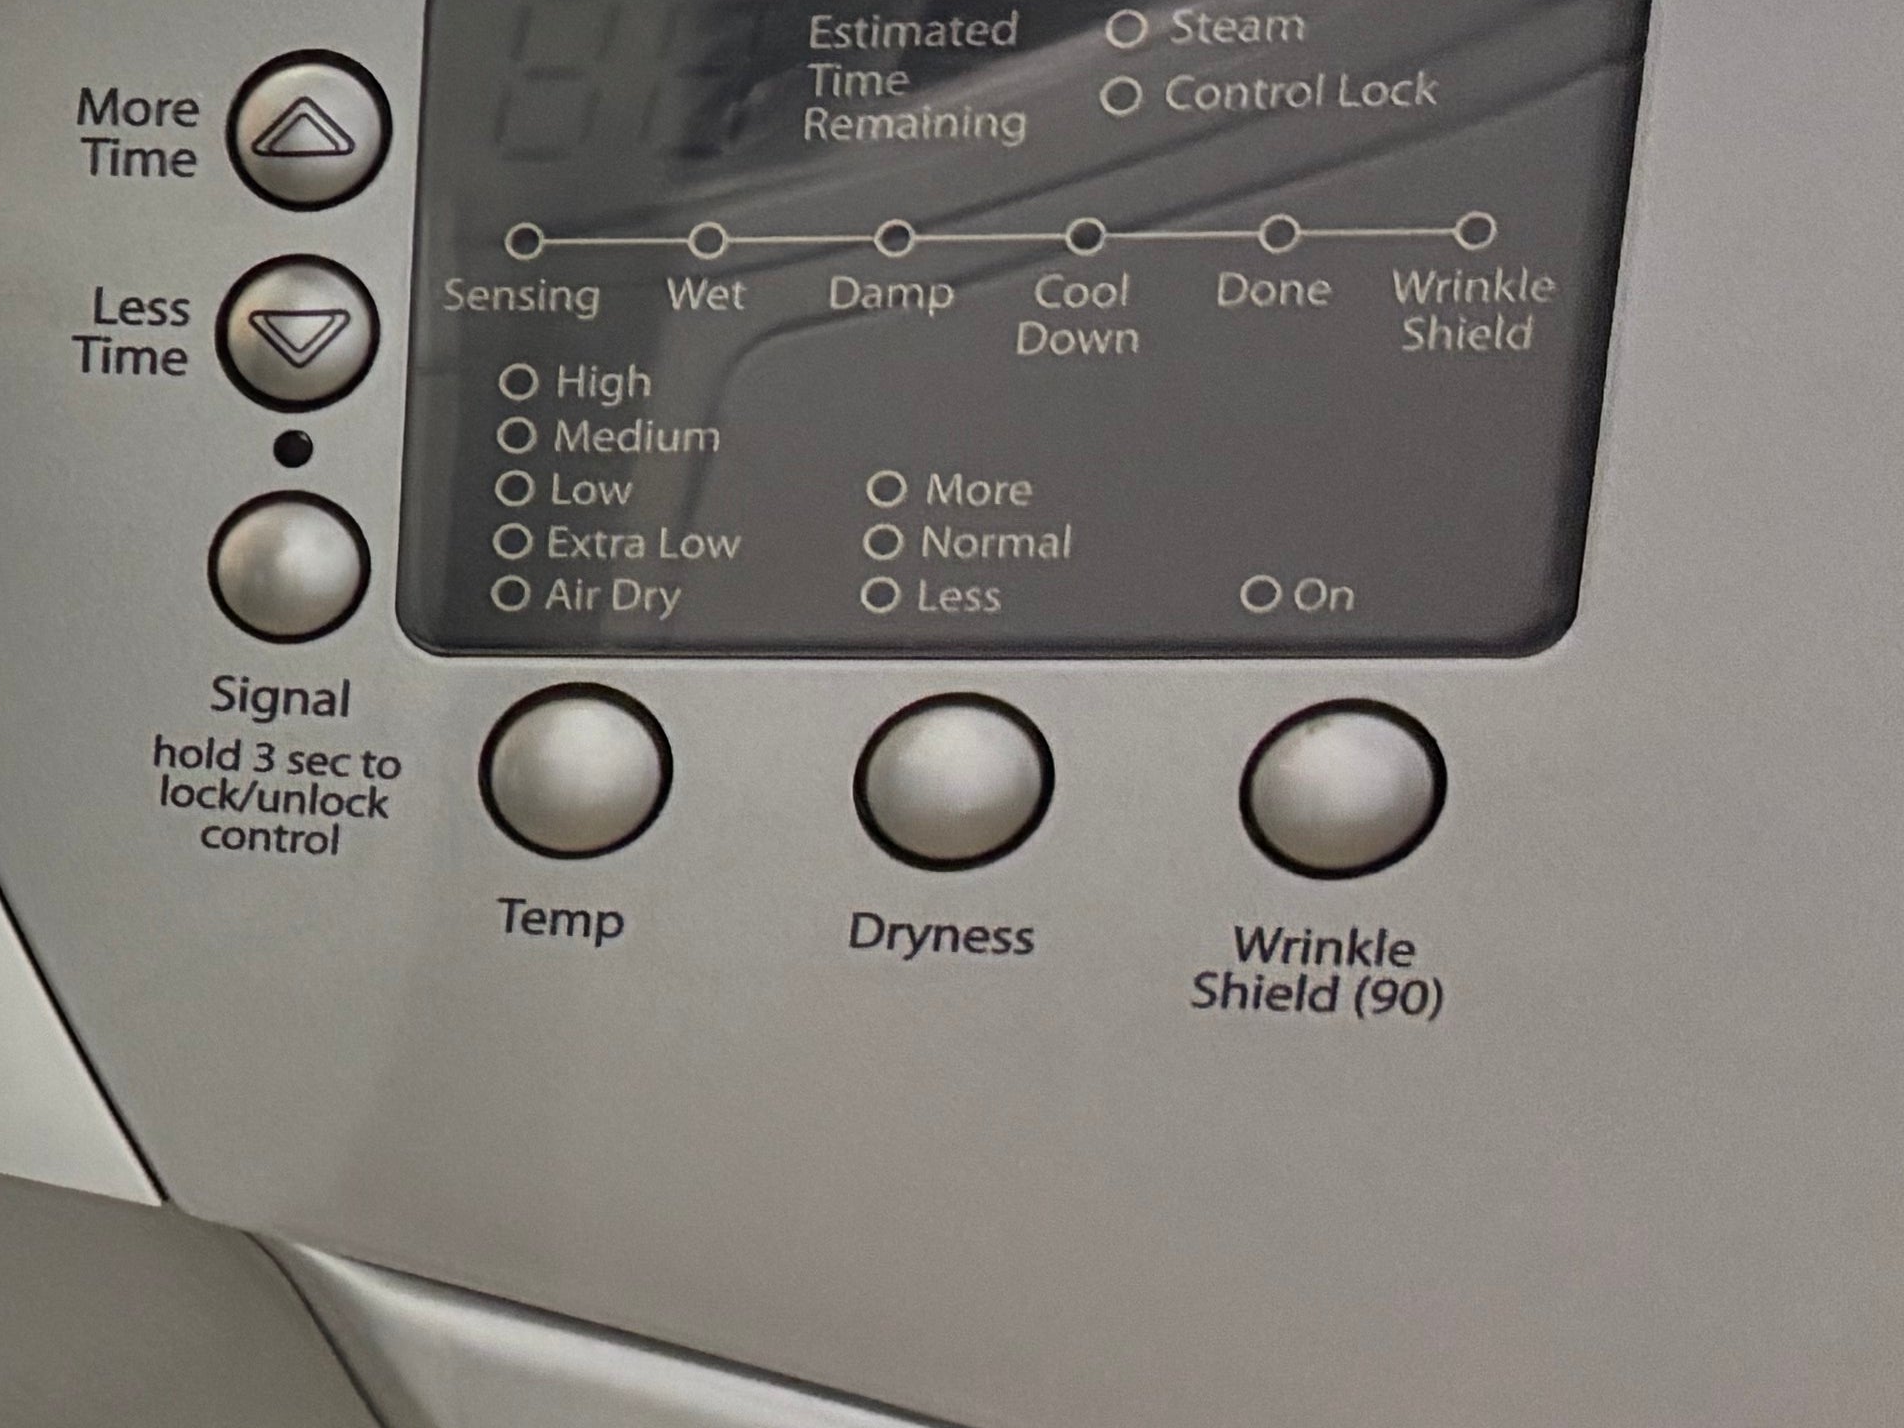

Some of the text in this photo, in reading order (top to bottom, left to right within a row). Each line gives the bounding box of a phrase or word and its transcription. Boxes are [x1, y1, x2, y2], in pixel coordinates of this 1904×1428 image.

[810, 10, 1018, 49] Estimated
[1170, 6, 1305, 44] Steam
[808, 63, 908, 96] Time
[1166, 71, 1437, 110] Control Lock
[77, 87, 199, 127] More
[804, 104, 1026, 147] Remaining
[81, 137, 197, 177] Time
[445, 278, 600, 320] Sensing
[667, 278, 745, 310] Wet
[830, 276, 954, 317] Damp
[1035, 273, 1129, 308] Cool
[1218, 272, 1331, 306] Done
[1393, 267, 1555, 304] Wrinkle
[94, 287, 190, 327] Less
[1017, 321, 1138, 355] Down
[1403, 314, 1533, 351] Shield
[72, 336, 188, 376] Time
[558, 364, 650, 407] High
[555, 419, 720, 452] Medium
[552, 473, 632, 505] Low
[927, 473, 1032, 506] More
[548, 526, 741, 559] Extra Low
[922, 524, 1071, 558] Normal
[545, 578, 681, 620] Air Dry
[919, 579, 1001, 612] Less
[1294, 578, 1354, 611] On
[211, 675, 350, 722] Signal
[154, 734, 401, 779] hold 3 sec to
[161, 775, 388, 818] lock/unlock
[201, 823, 339, 855] control
[498, 898, 624, 947] Temp
[850, 912, 1034, 961] Dryness
[1235, 926, 1415, 967] Wrinkle
[1192, 971, 1443, 1021] Shield (90)
